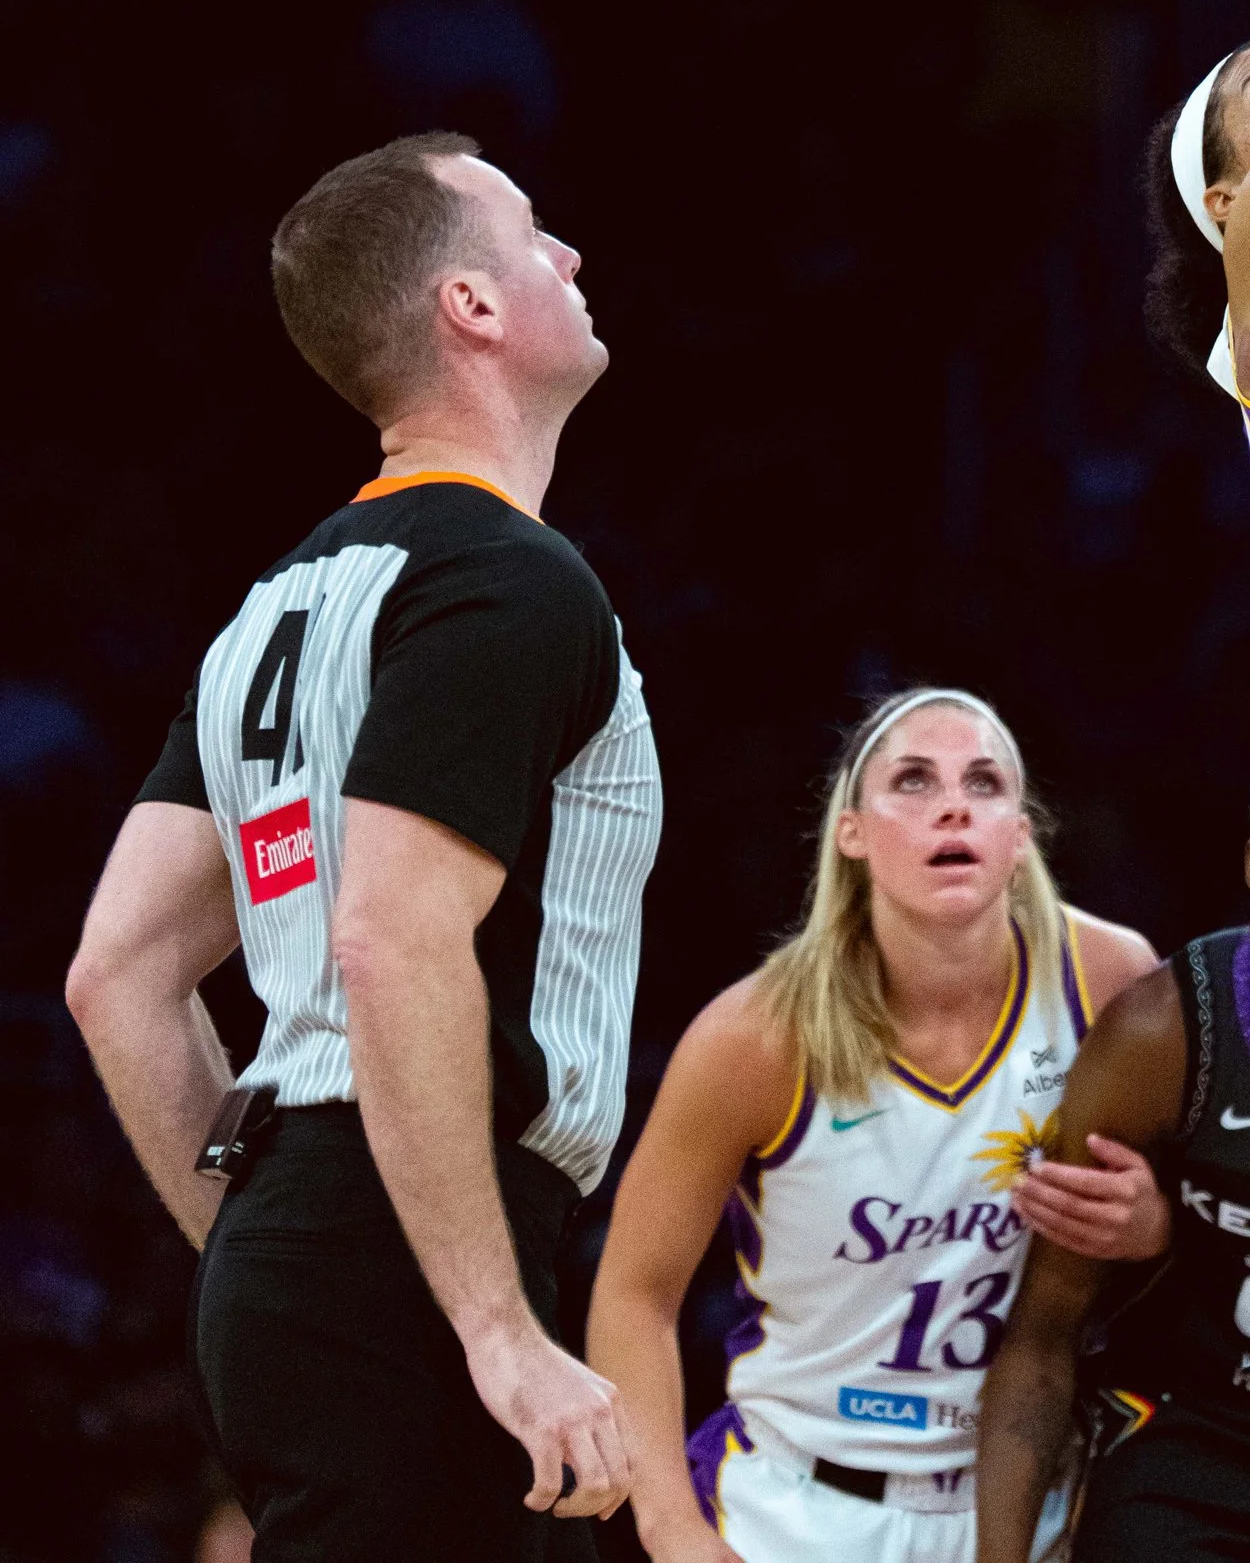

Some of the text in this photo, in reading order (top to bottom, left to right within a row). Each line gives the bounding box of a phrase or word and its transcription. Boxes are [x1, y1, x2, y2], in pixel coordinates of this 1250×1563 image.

[240, 606, 314, 787] 4
[253, 826, 315, 879] Emirate
[878, 1271, 1012, 1373] 13
[849, 1397, 918, 1421] UCLA
